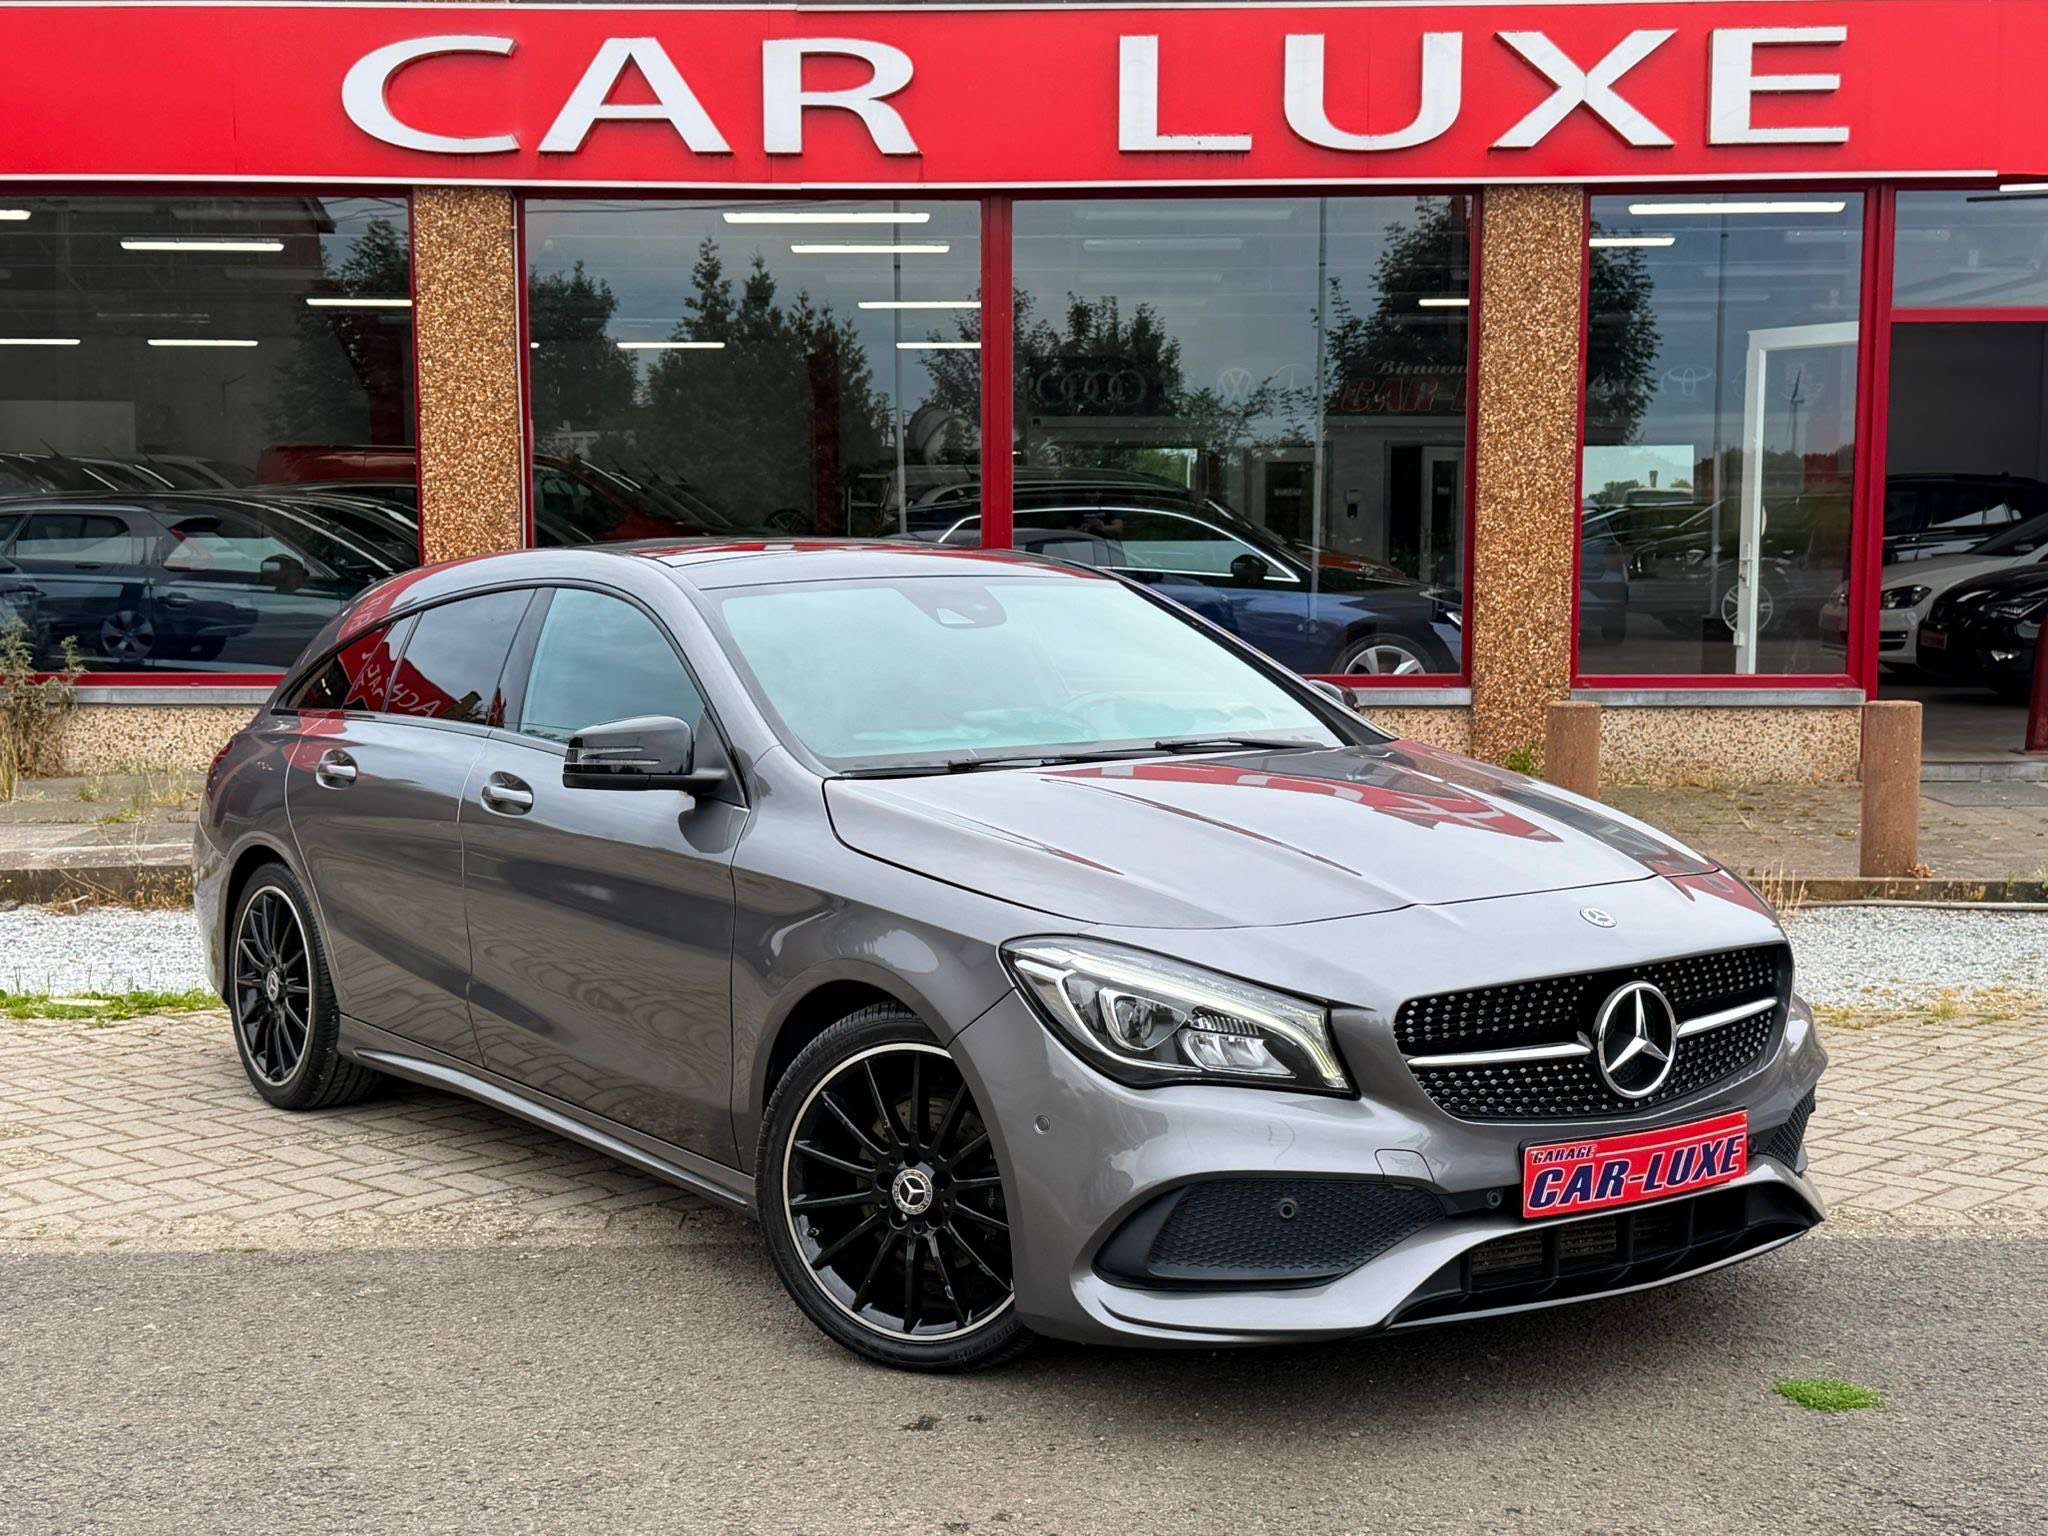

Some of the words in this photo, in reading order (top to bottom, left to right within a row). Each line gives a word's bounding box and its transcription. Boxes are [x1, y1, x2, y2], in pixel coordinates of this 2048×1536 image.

[342, 35, 924, 156] CAR
[1118, 26, 1850, 152] LUXE
[1528, 1134, 1745, 1210] CAR-LUXE
[1532, 1145, 1596, 1165] GARAGE
